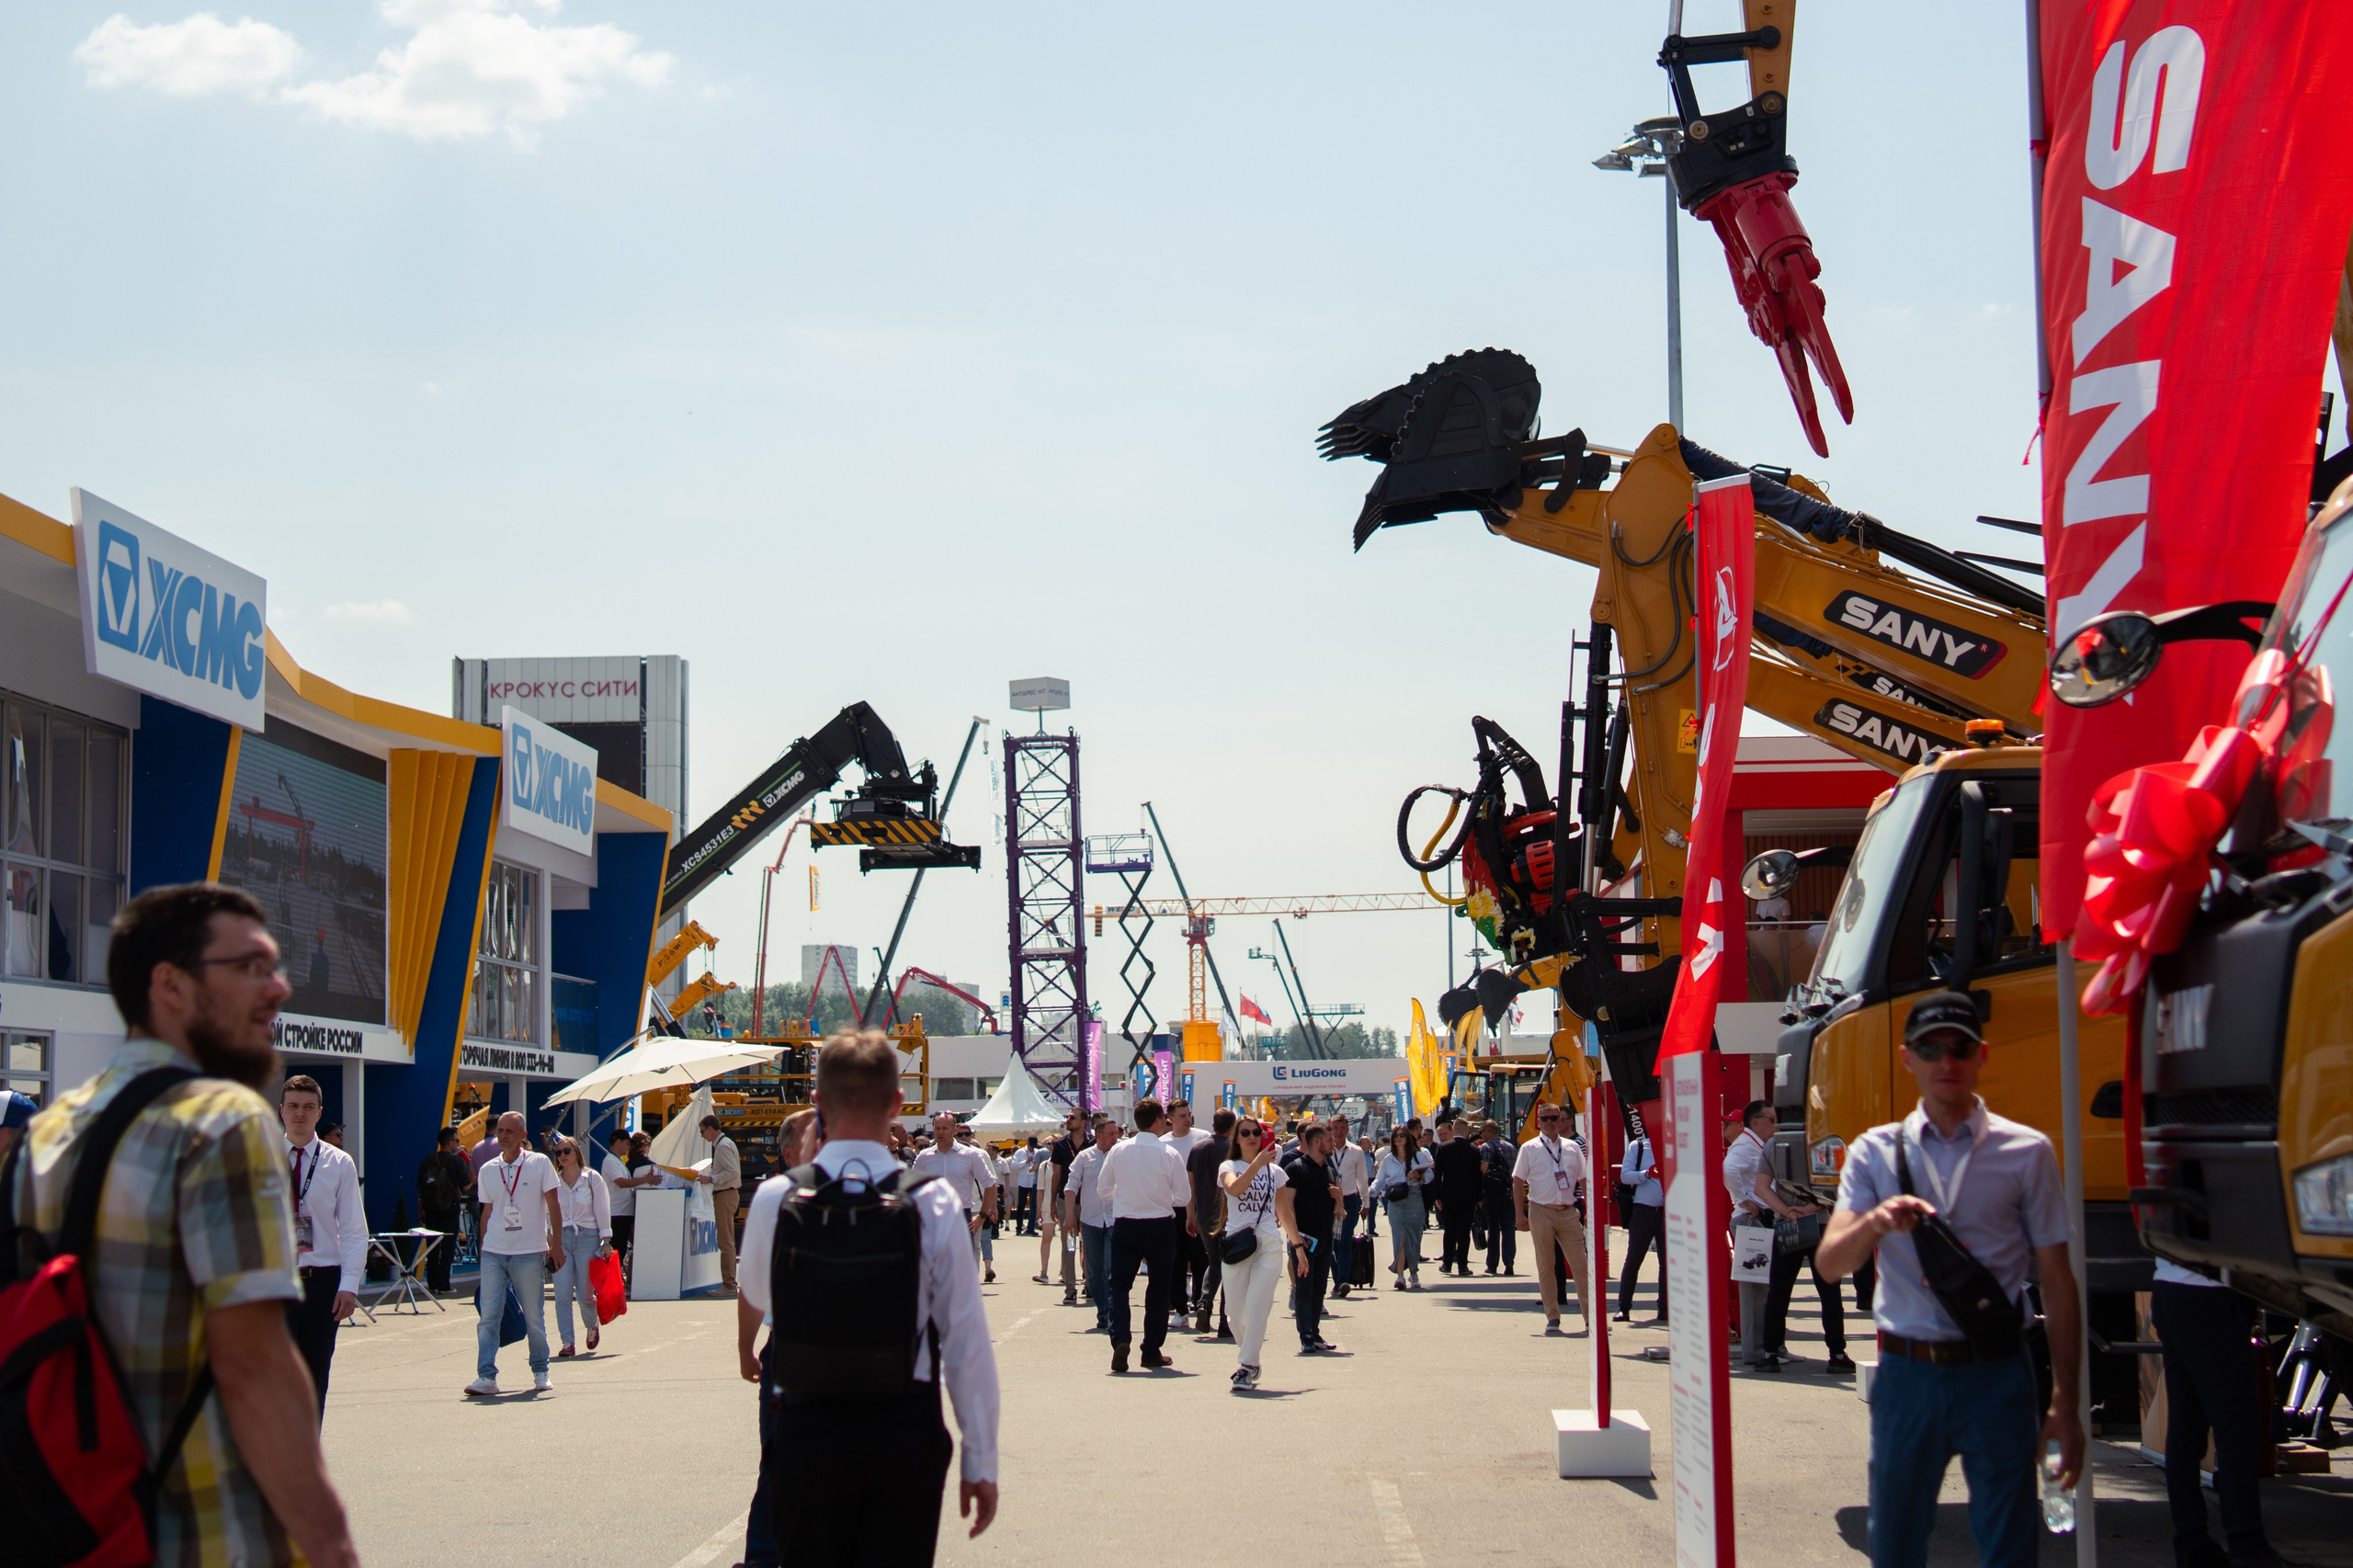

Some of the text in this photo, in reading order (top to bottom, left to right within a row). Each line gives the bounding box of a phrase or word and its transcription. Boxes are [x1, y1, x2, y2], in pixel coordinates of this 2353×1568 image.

[139, 556, 264, 699] XCMG
[1841, 597, 1976, 666] SANY
[490, 680, 638, 699] КРОКУС СИТИ
[531, 743, 593, 835] XCMG
[774, 770, 805, 800] XCMG
[681, 825, 734, 873] XCS4531E3
[284, 1021, 325, 1051] СТРОЙКЕ
[326, 1028, 363, 1054] РОССИИ
[460, 1044, 489, 1066] ГОРЯЧАЯ
